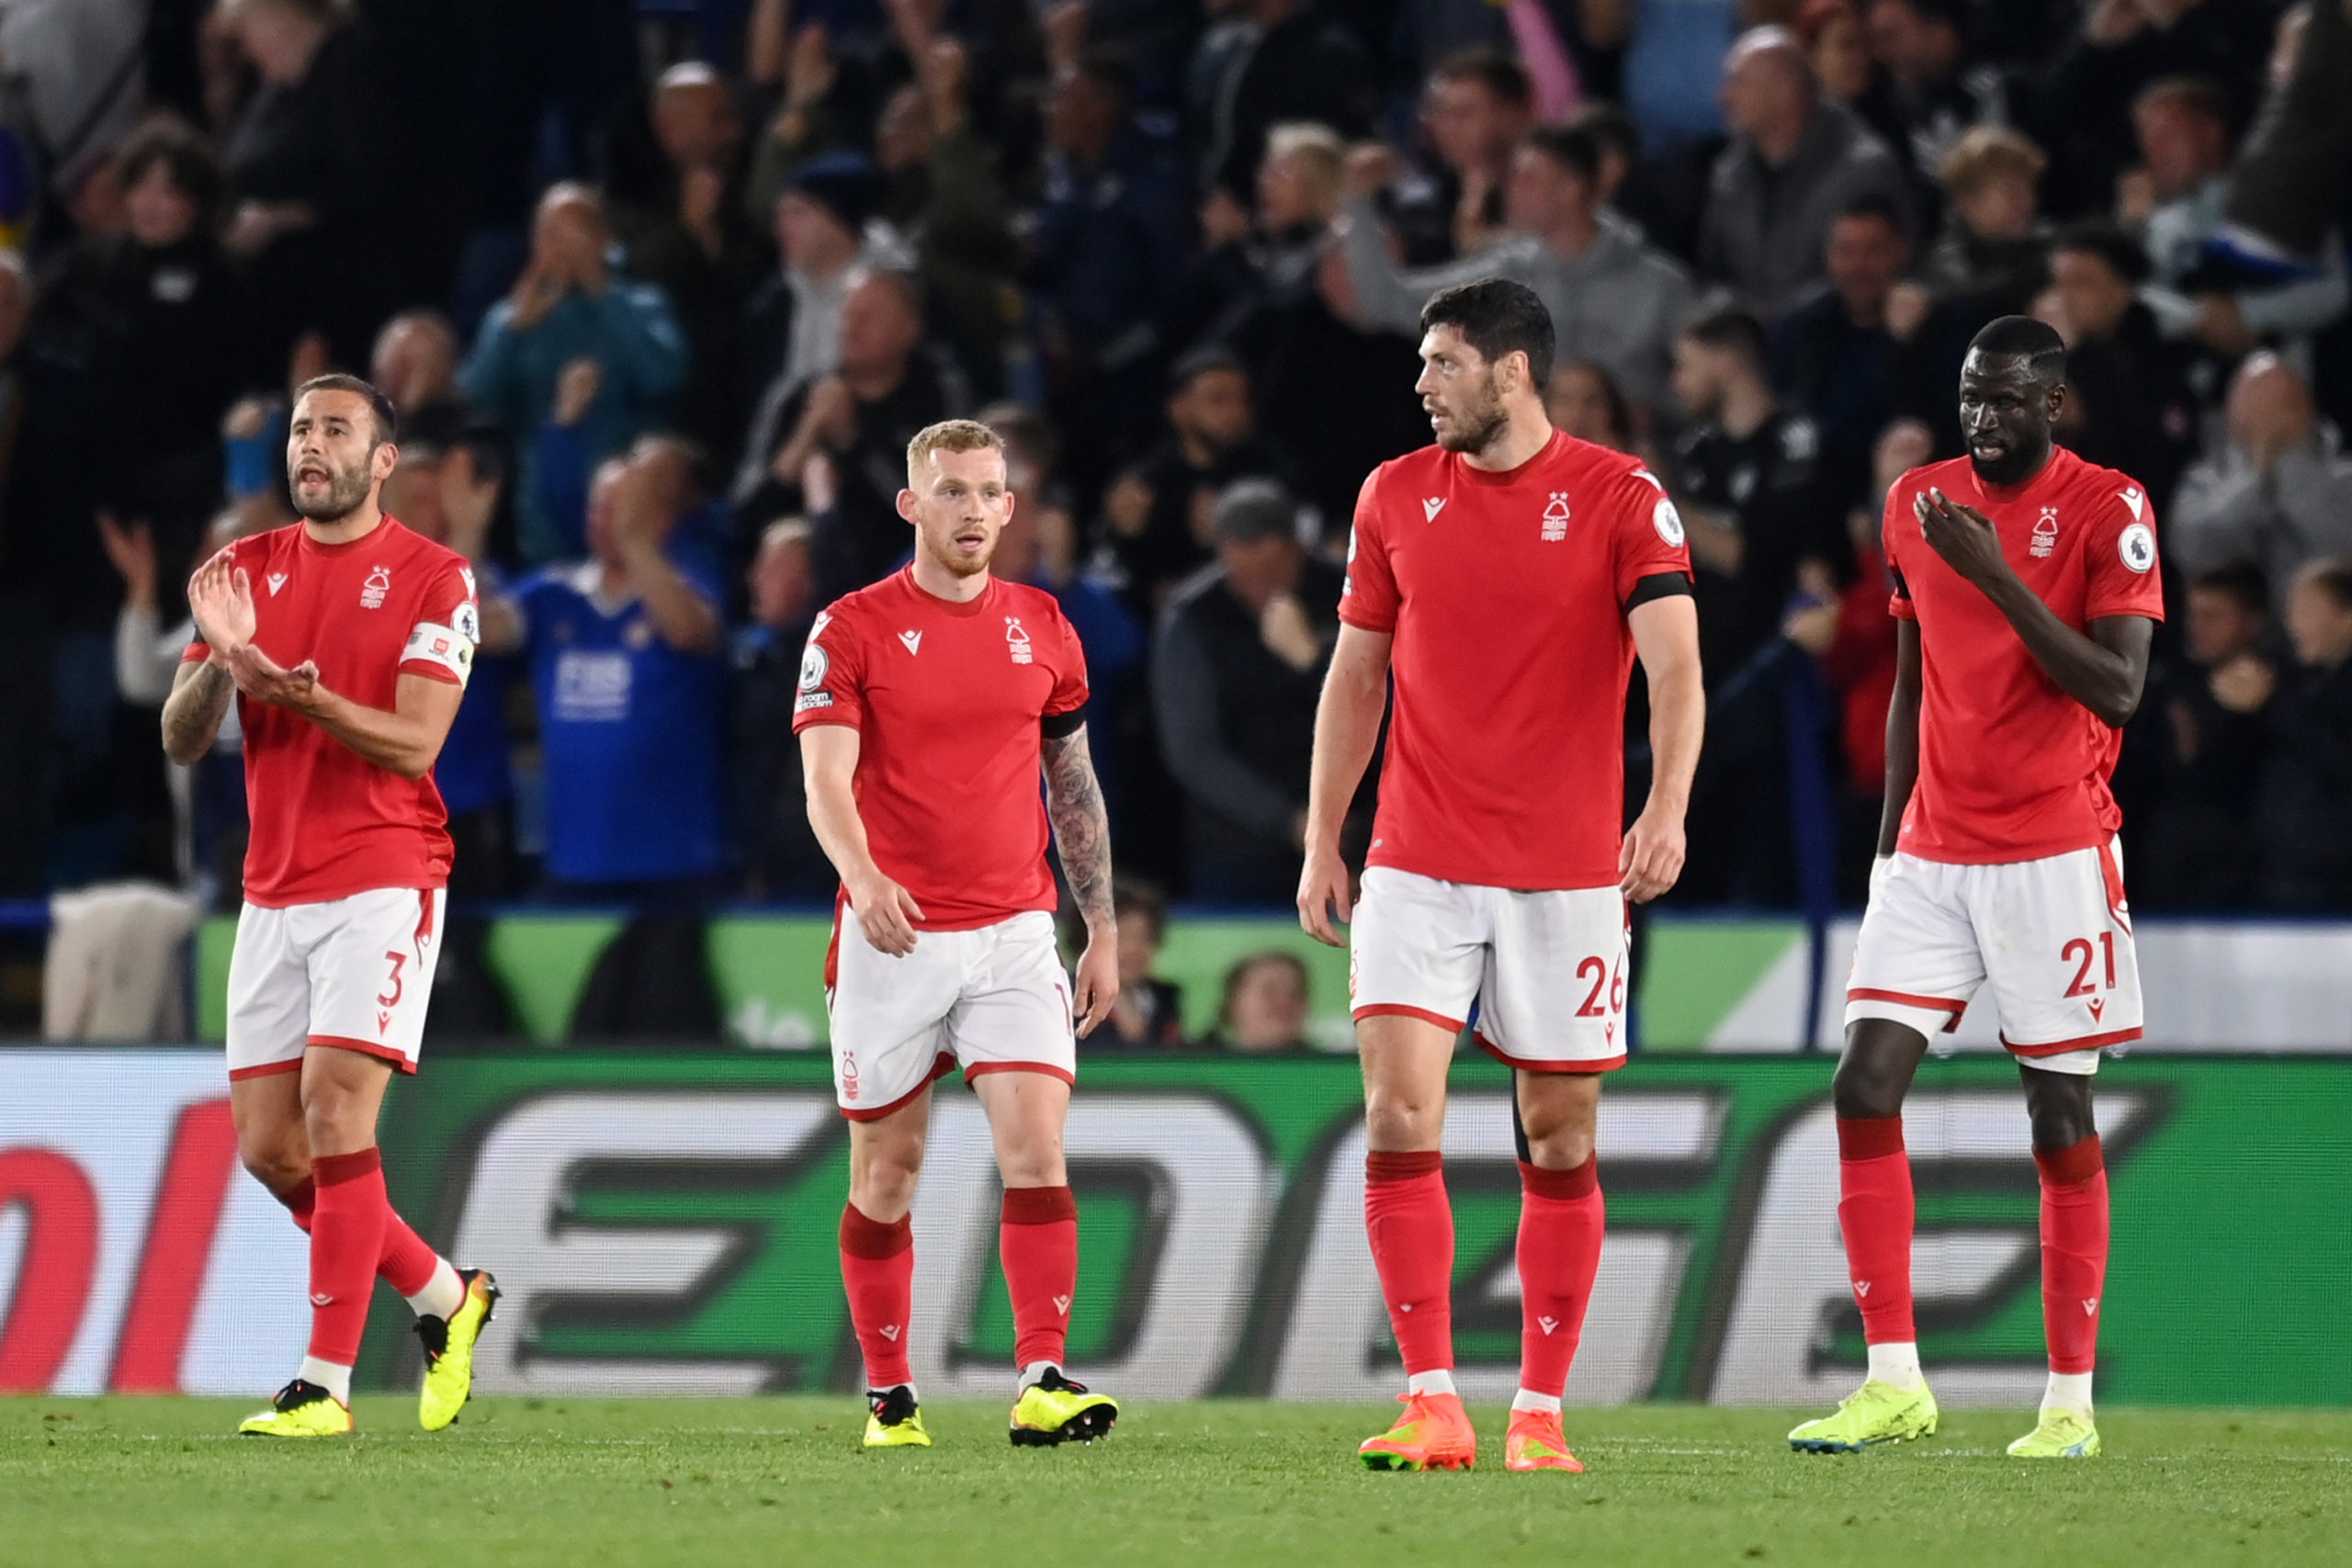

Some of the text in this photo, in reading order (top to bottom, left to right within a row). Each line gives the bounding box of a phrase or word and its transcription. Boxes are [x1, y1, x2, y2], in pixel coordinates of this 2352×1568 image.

[377, 950, 407, 1008] 3
[1574, 952, 1623, 1017] 26
[2061, 931, 2116, 998] 21
[418, 1089, 2154, 1402] EDGE
